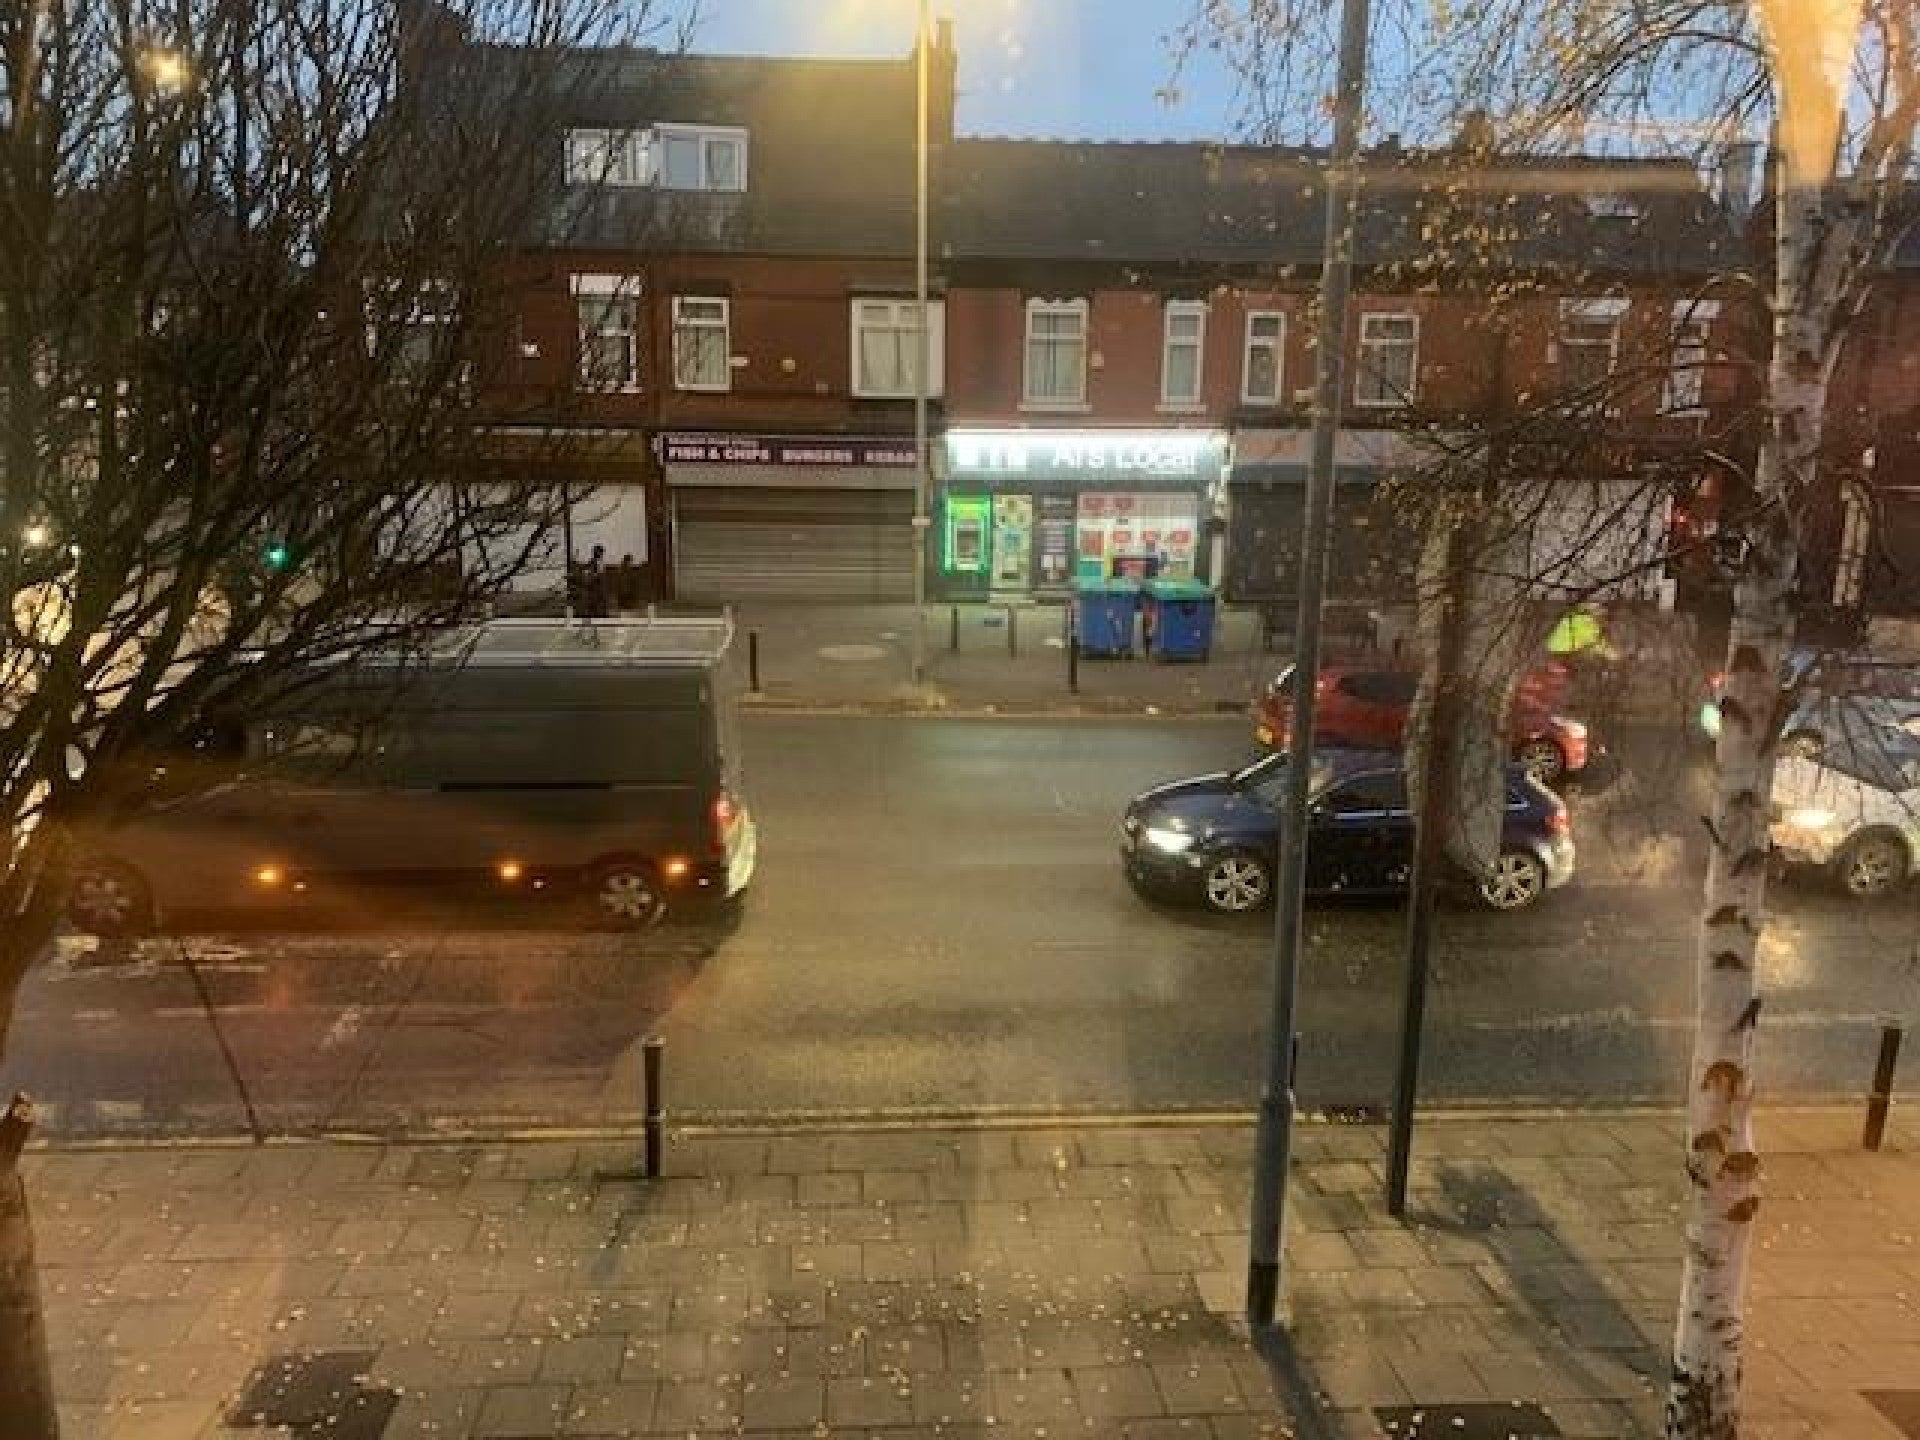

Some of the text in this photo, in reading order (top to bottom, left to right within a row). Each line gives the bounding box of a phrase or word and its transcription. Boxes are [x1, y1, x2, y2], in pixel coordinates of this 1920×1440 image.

[668, 446, 769, 462] FISH & CHIPS
[782, 449, 853, 463] BURGERS
